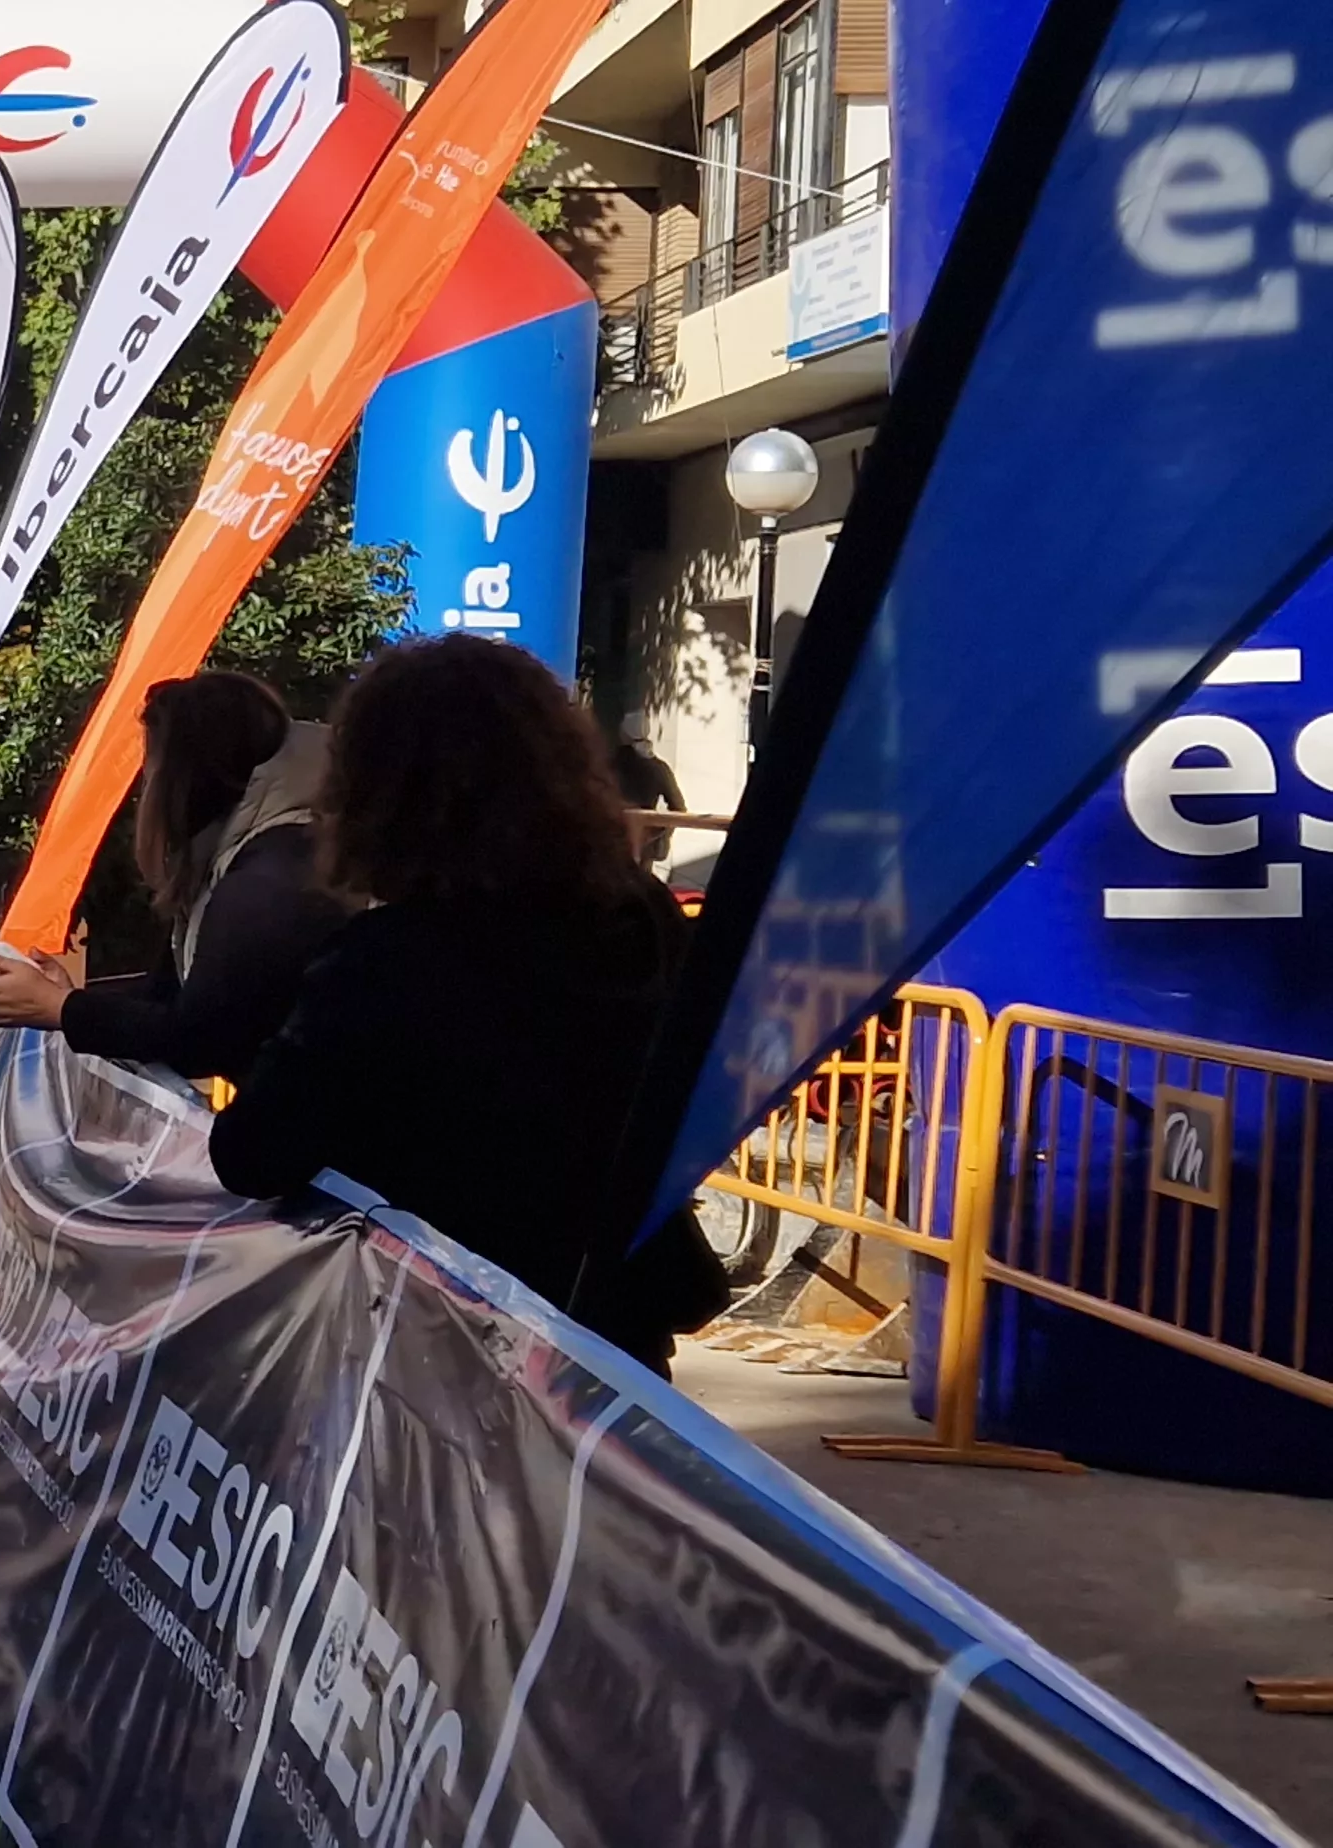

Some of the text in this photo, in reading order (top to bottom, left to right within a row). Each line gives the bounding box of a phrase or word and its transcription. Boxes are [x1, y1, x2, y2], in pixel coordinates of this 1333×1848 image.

[0, 235, 211, 584] Ibercaja
[443, 562, 521, 640] ja
[151, 1425, 293, 1660] ESIC
